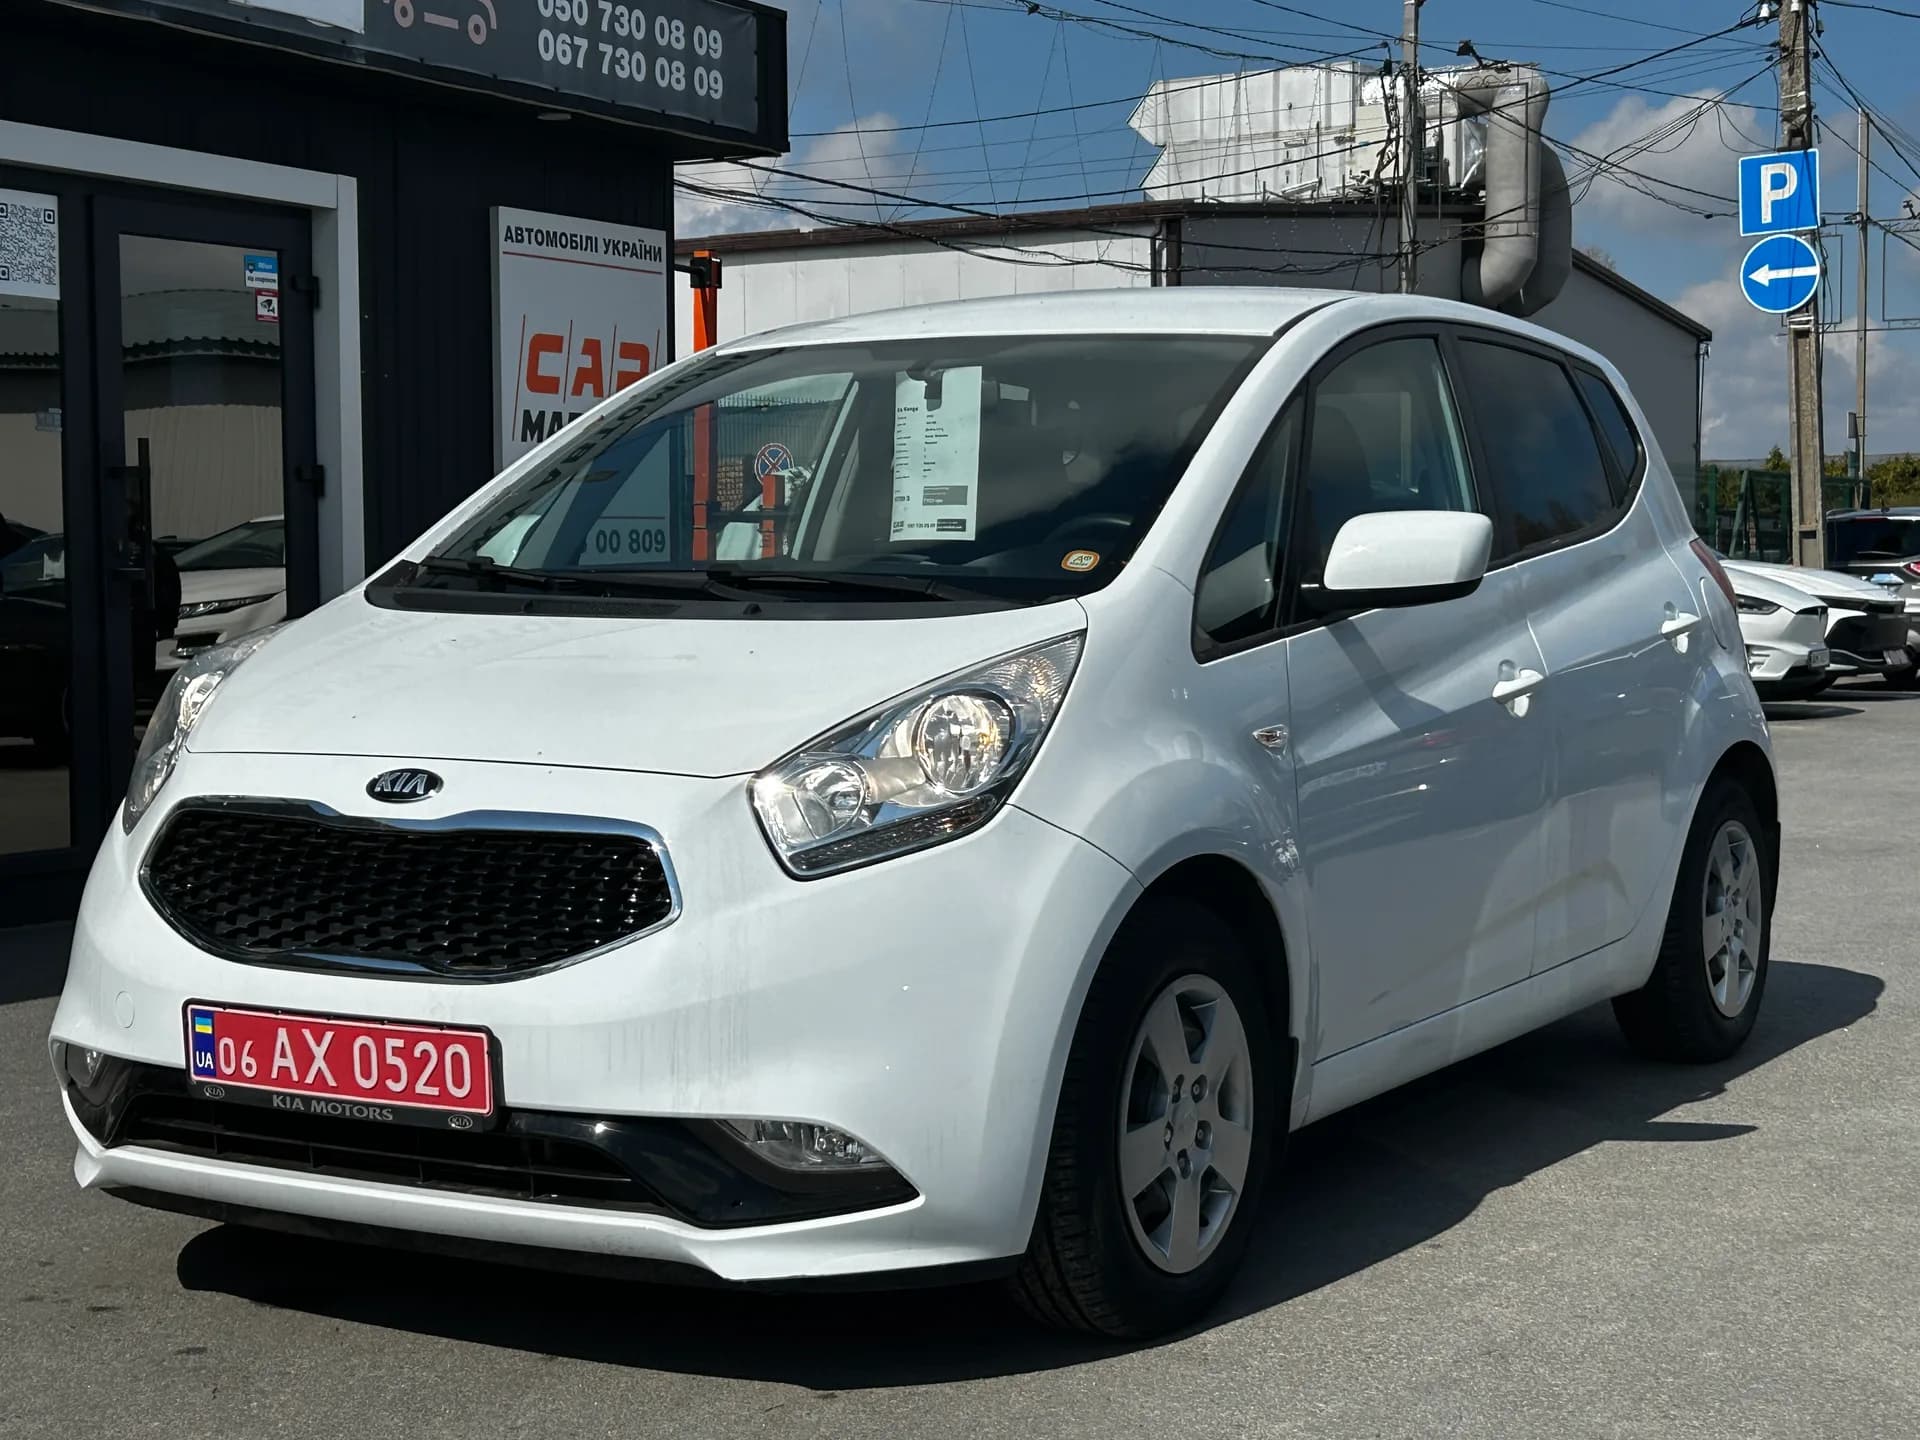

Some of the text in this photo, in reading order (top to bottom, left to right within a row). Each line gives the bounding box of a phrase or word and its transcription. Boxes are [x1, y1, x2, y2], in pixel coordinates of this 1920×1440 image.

[538, 0, 722, 59] 050 730 08 09
[538, 28, 723, 100] 067 730 08 09
[1760, 162, 1798, 225] P
[504, 225, 663, 263] АВТОМОБІЛІ УКРАЇНИ
[596, 529, 666, 554] 00 809
[374, 771, 428, 795] KIA
[196, 1050, 214, 1069] UA
[219, 1027, 472, 1098] 06 AX 0520
[272, 1094, 394, 1122] KIA MOTORS
